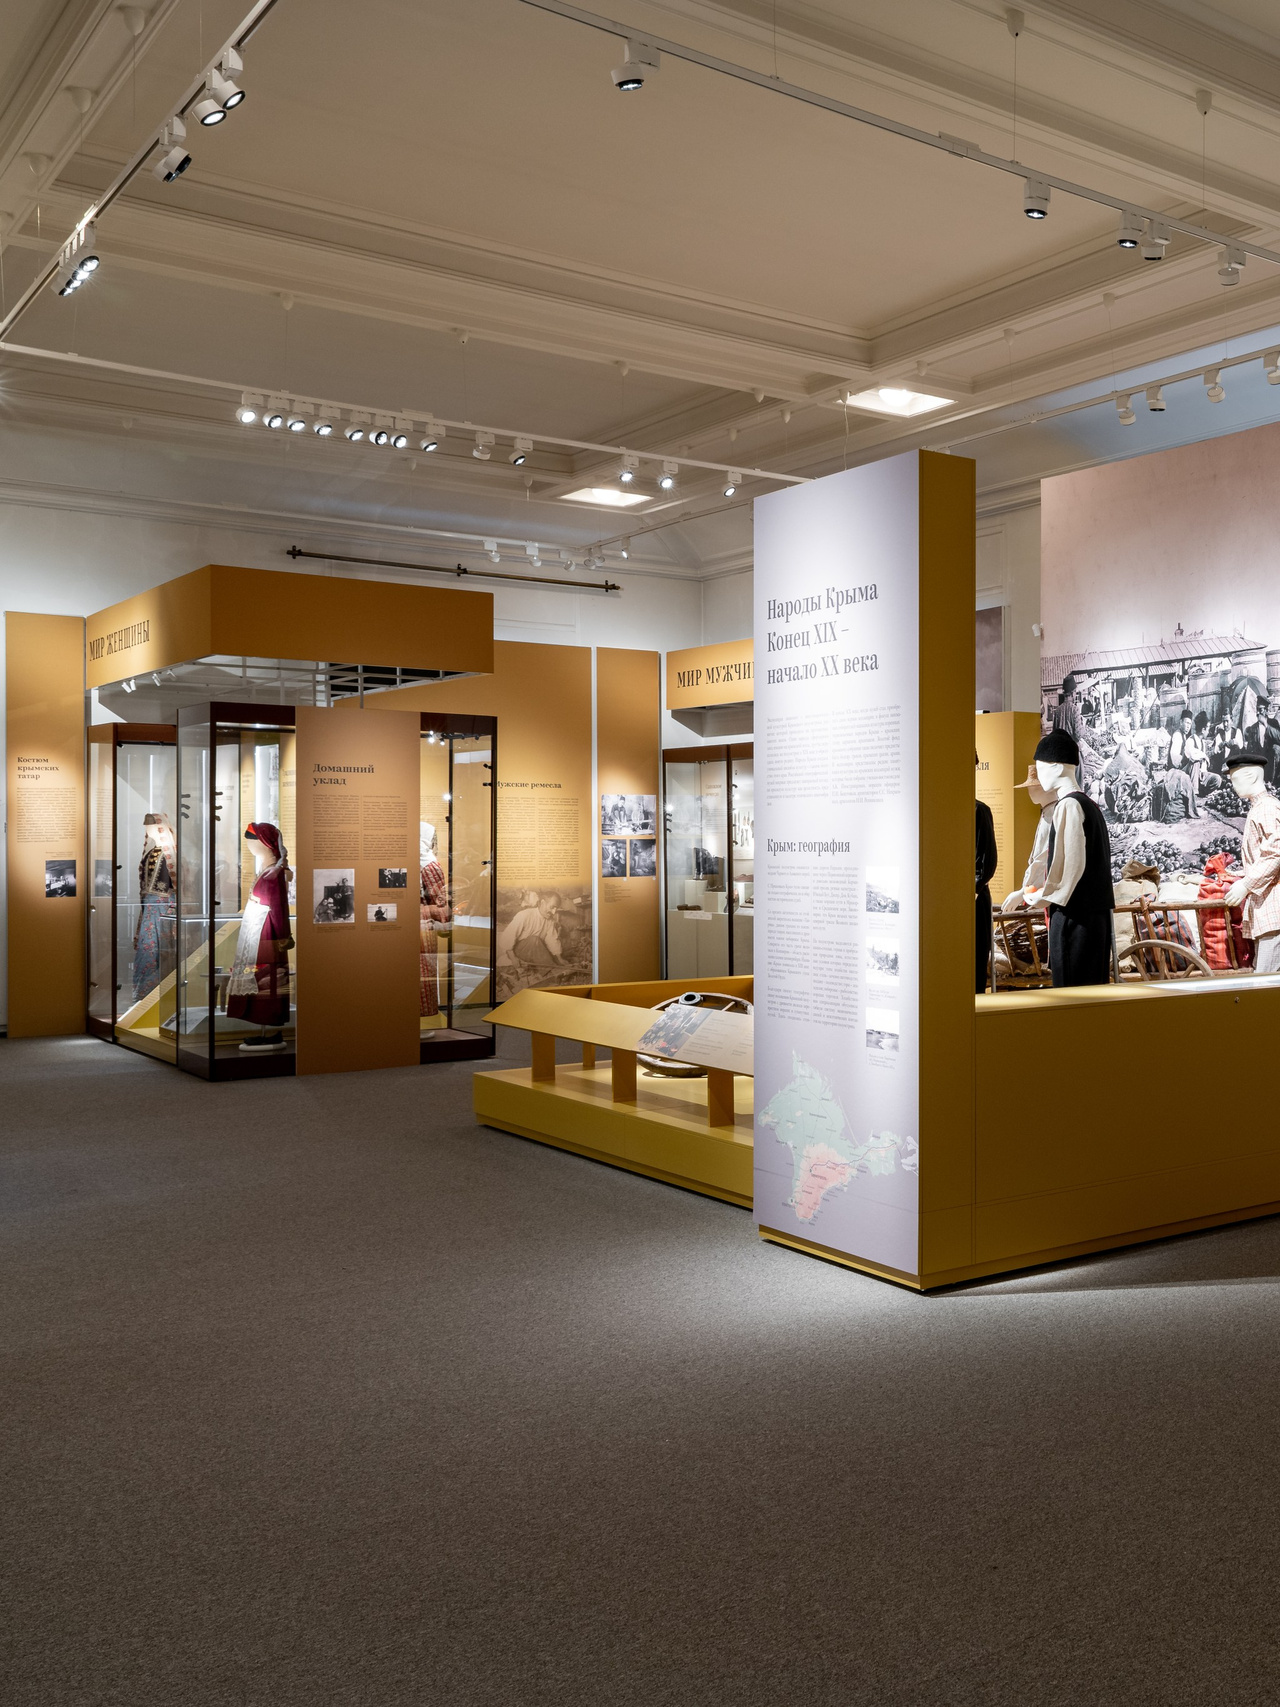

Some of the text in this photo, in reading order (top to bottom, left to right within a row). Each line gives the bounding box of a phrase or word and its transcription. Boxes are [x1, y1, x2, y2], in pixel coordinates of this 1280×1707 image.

[766, 580, 879, 622] Народы Крыма
[89, 619, 150, 661] МИР ЖЕНЩИНЫ
[766, 619, 838, 654] Конец XIX
[677, 661, 754, 688] МИР МУЖЧИ
[766, 650, 880, 686] начало XX века
[17, 756, 49, 764] Костюм
[17, 765, 59, 773] крымских
[312, 763, 375, 774] Домашний
[17, 773, 41, 781] татар
[313, 776, 347, 787] уклад
[767, 837, 851, 857] Крым: география
